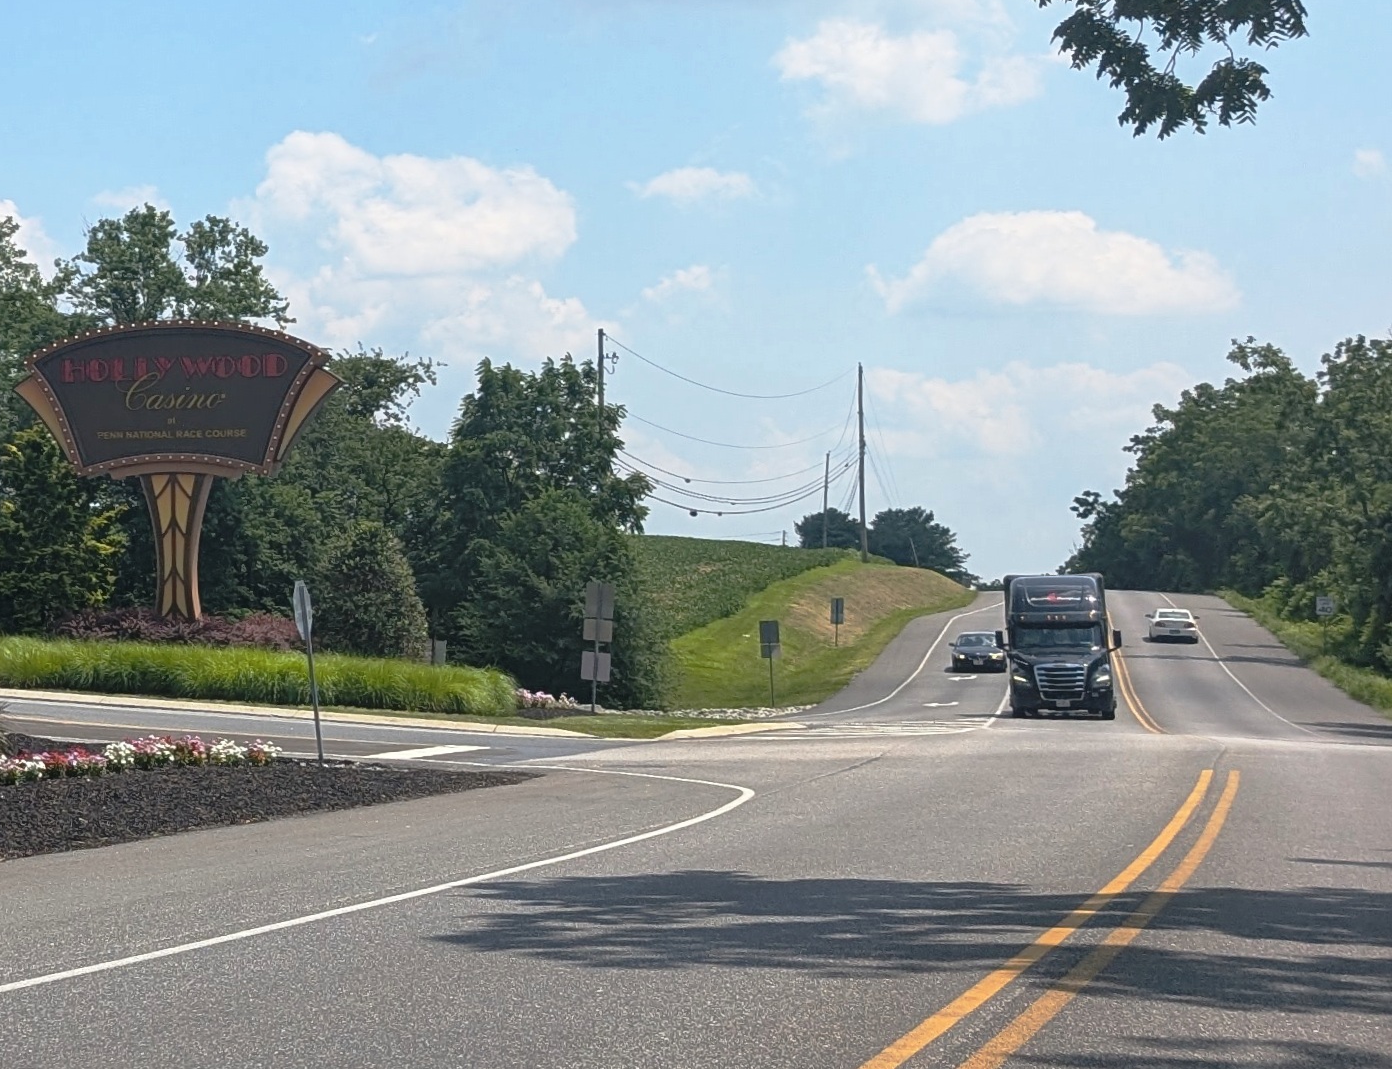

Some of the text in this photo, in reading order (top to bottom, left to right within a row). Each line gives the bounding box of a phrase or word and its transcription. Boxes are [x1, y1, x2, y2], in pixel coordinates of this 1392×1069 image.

[62, 353, 288, 383] HOLLYWOOD
[115, 372, 225, 411] Casino
[97, 428, 247, 440] PENN NATIONAL RACE COURSE
